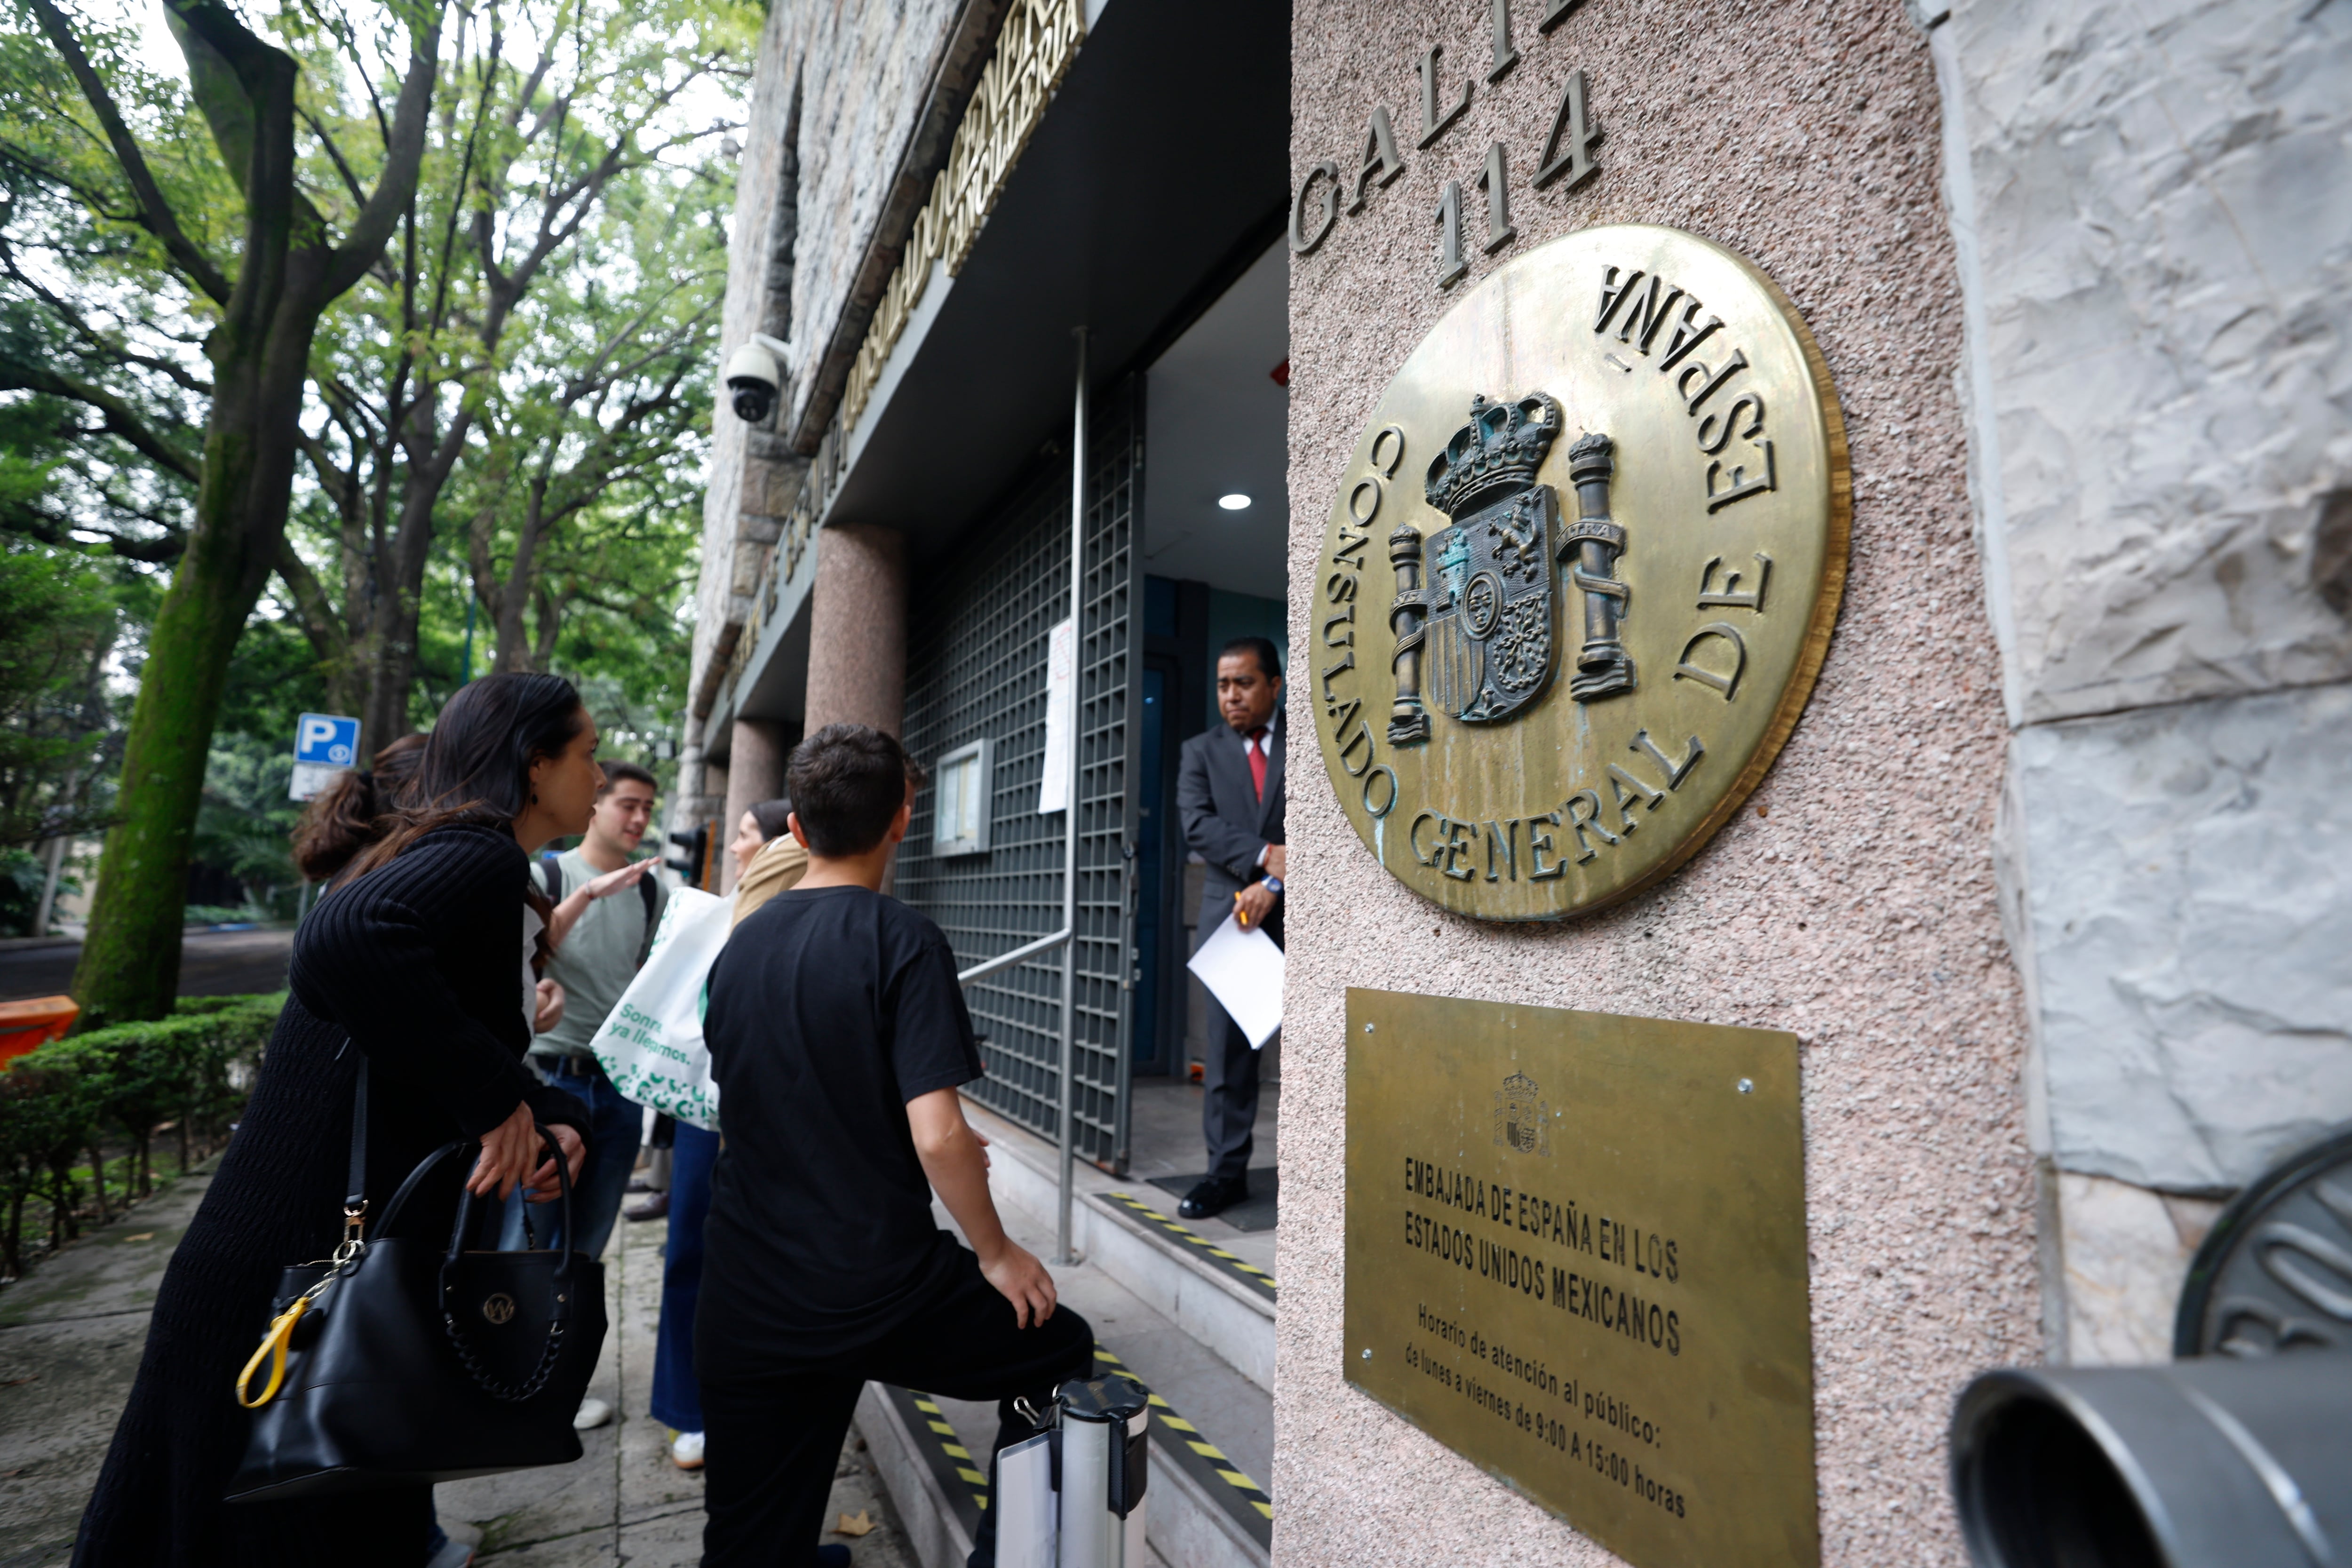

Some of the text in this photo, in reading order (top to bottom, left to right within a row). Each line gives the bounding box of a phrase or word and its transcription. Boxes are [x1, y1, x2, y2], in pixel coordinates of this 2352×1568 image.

[1289, 0, 1573, 255] GALI
[1434, 70, 1600, 288] 114
[1321, 263, 1777, 882] CONSULADO GENERAL DE ESPAÑA
[301, 719, 337, 753] P
[608, 1022, 630, 1039] ya
[1406, 1157, 1678, 1285] EMBAJADA DE ESPAÑA EN LOS
[1406, 1210, 1680, 1356] ESTADOS UNIDOS MEXICANOS
[1406, 1341, 1686, 1519] de lunes a viernes de 9:00 A 15:00 horas
[1418, 1303, 1661, 1449] Horario de atención al público:
